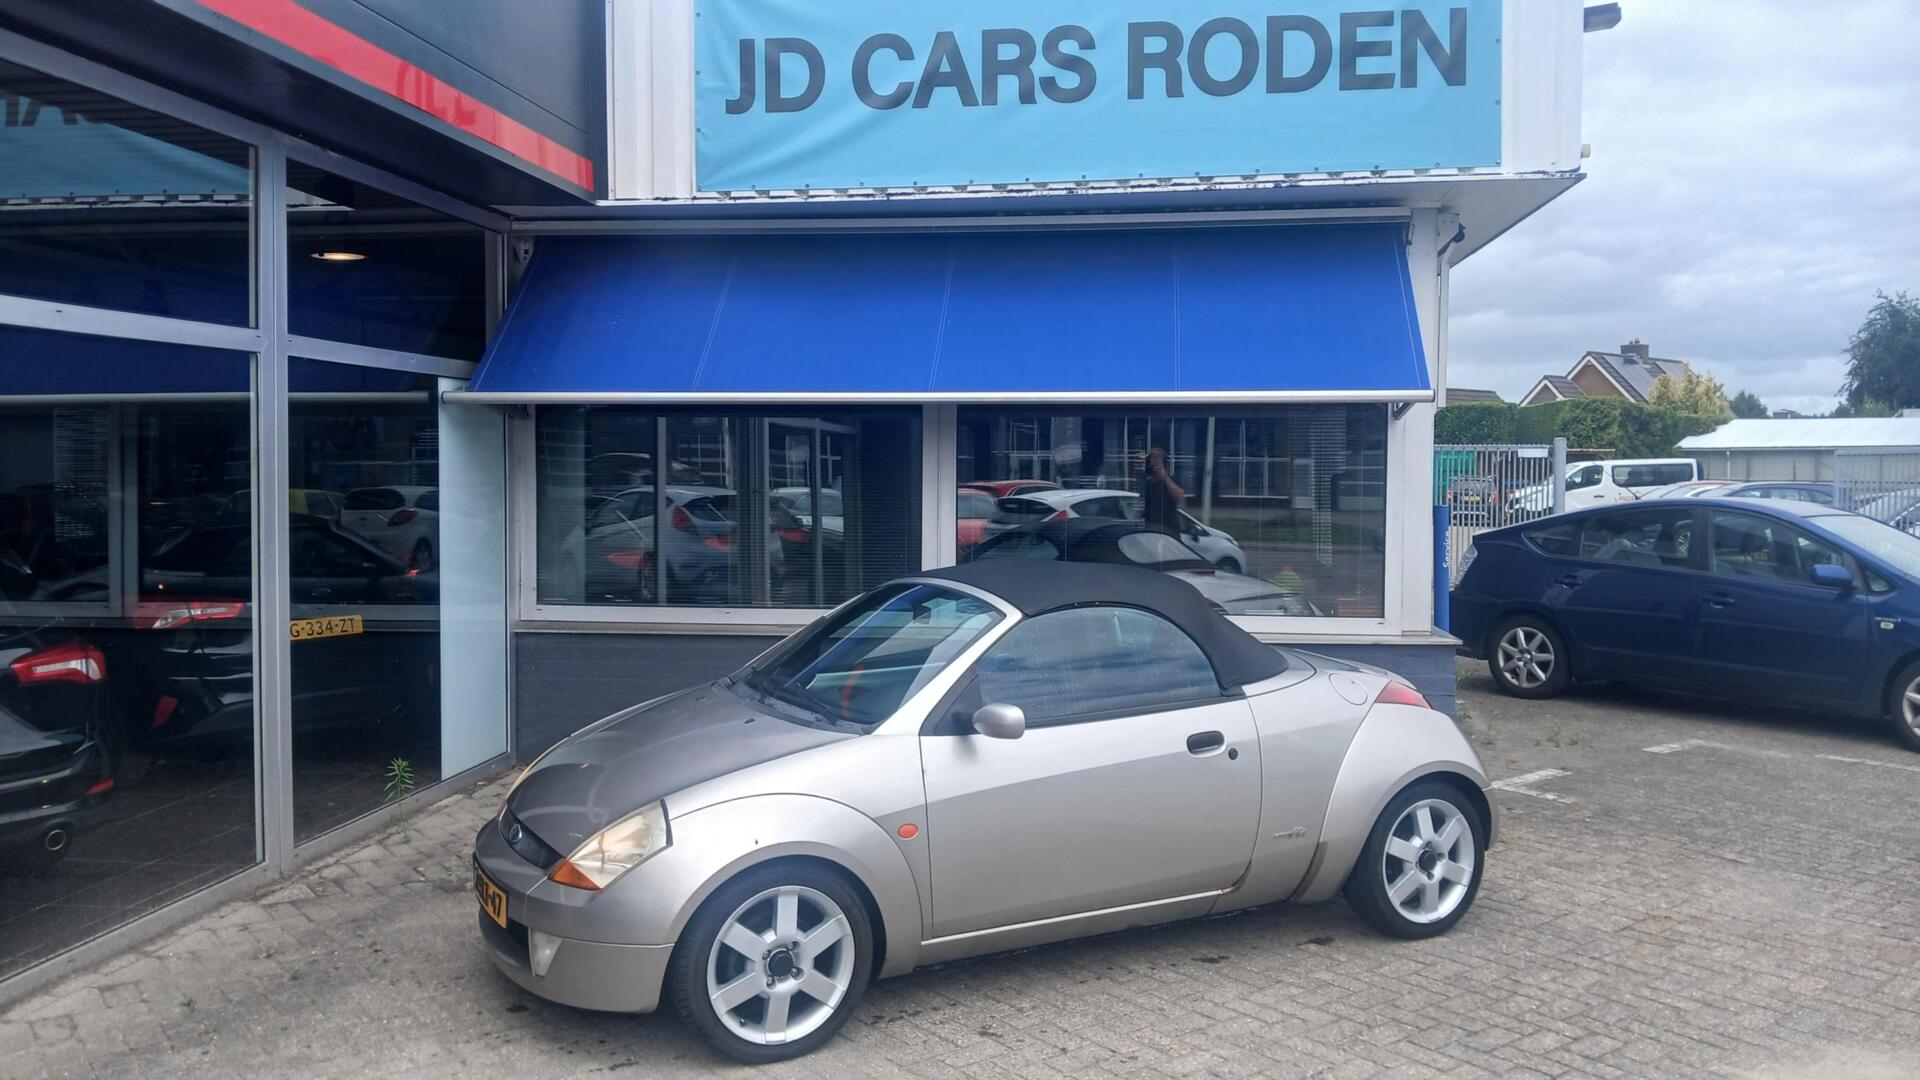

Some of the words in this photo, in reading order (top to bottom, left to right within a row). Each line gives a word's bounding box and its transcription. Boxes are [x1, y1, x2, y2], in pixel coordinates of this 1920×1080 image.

[725, 37, 826, 115] JD
[852, 24, 1097, 110] CARS
[1127, 7, 1467, 100] RODEN
[290, 618, 355, 637] G-334-ZT
